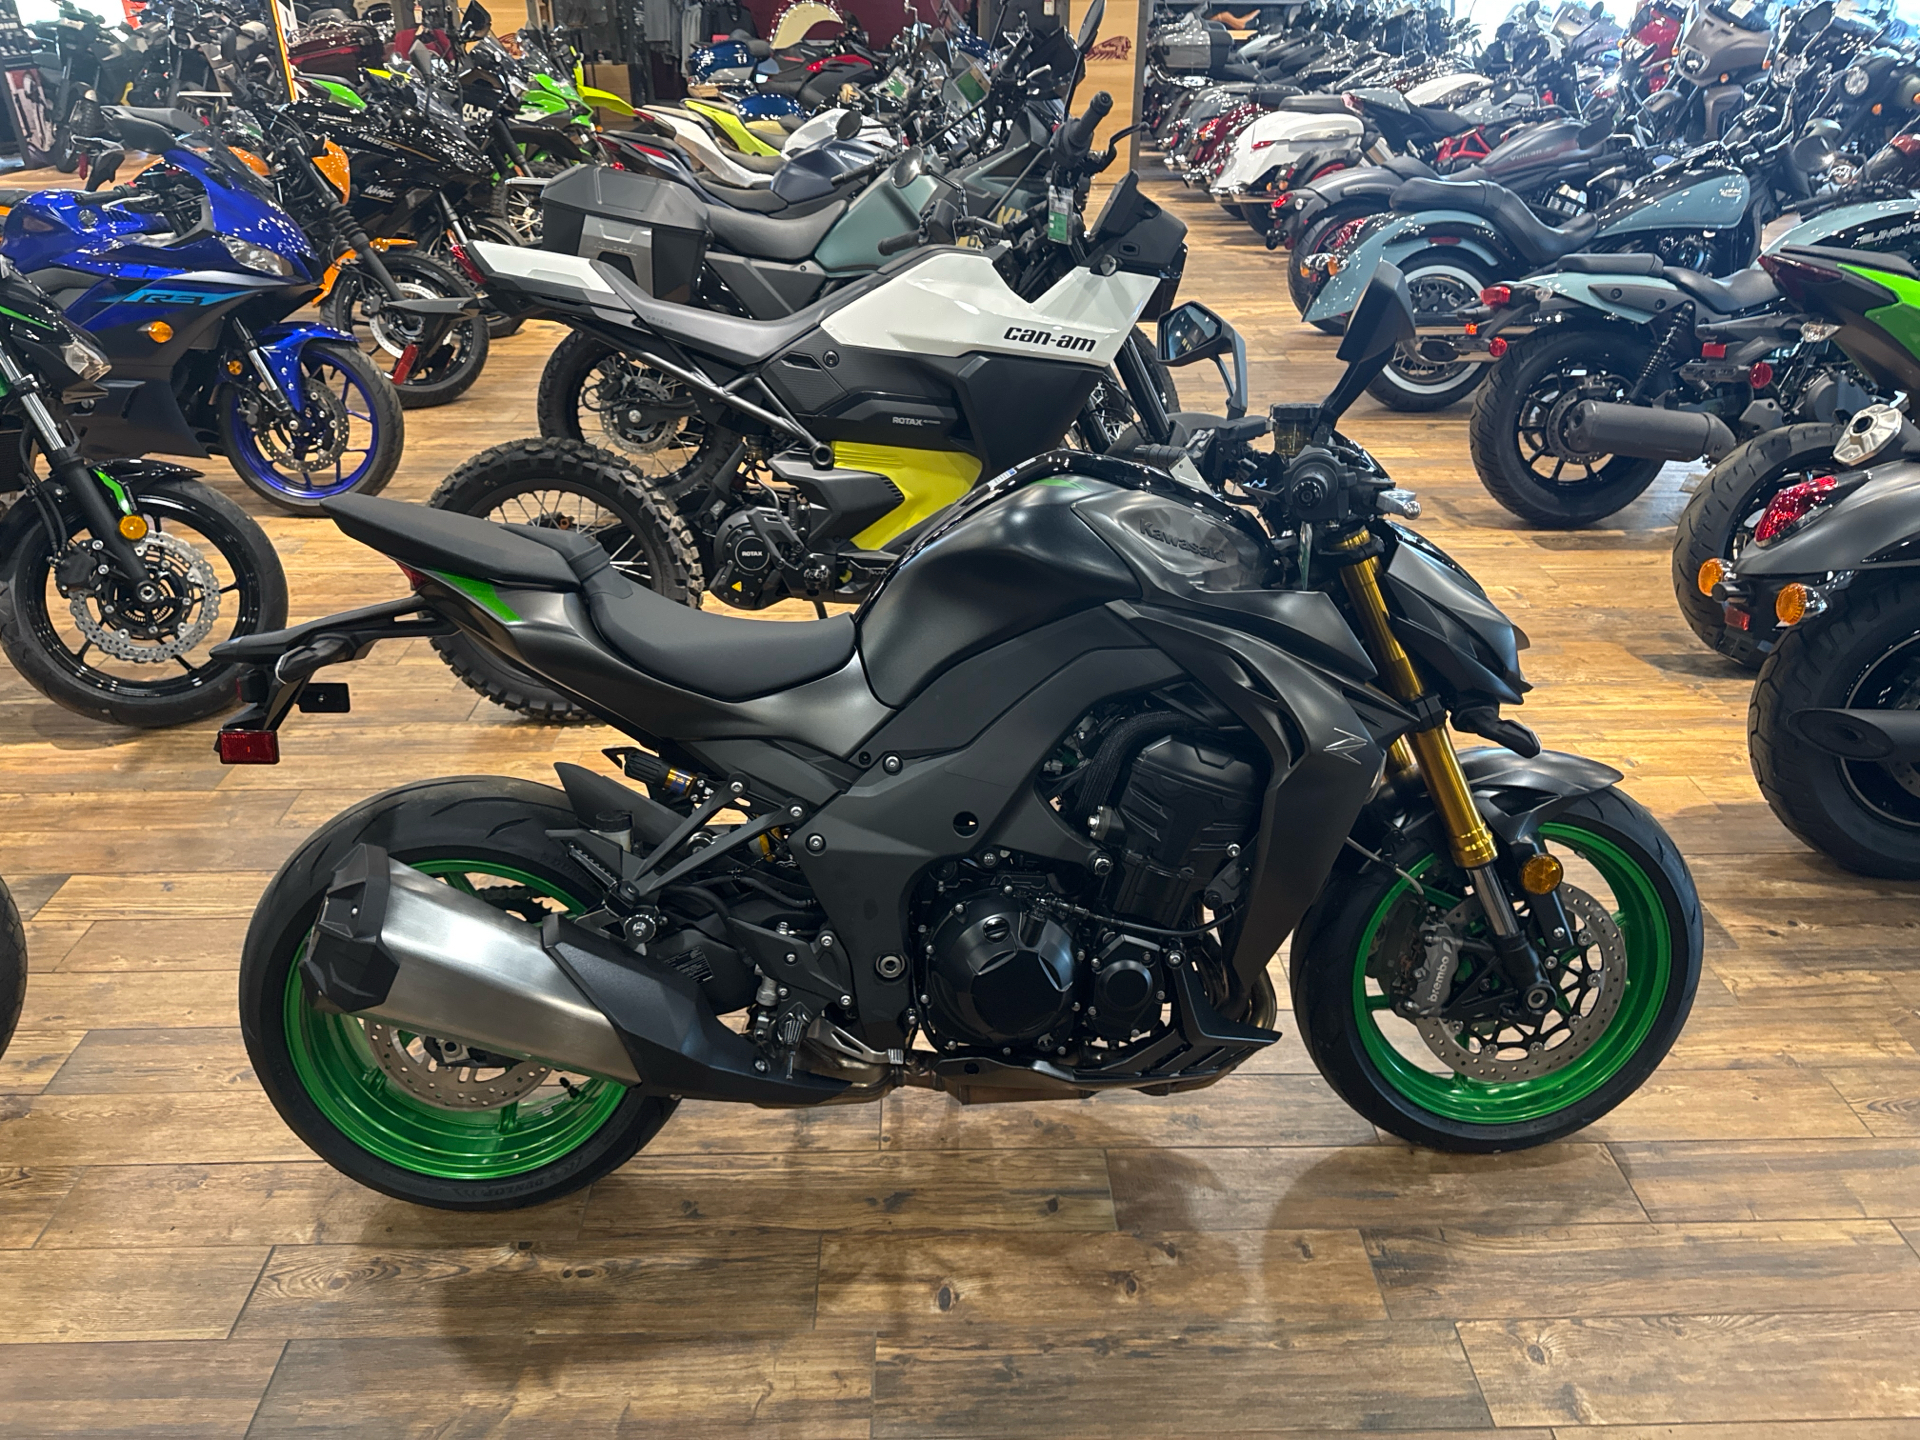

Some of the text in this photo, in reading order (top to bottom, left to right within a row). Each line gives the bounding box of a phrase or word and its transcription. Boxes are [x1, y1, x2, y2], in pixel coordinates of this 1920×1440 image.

[364, 184, 396, 198] Ninja
[1003, 326, 1097, 352] can-am
[892, 416, 923, 427] ROTAX
[1140, 518, 1227, 563] Kawasaki
[1427, 955, 1450, 1003] brembo
